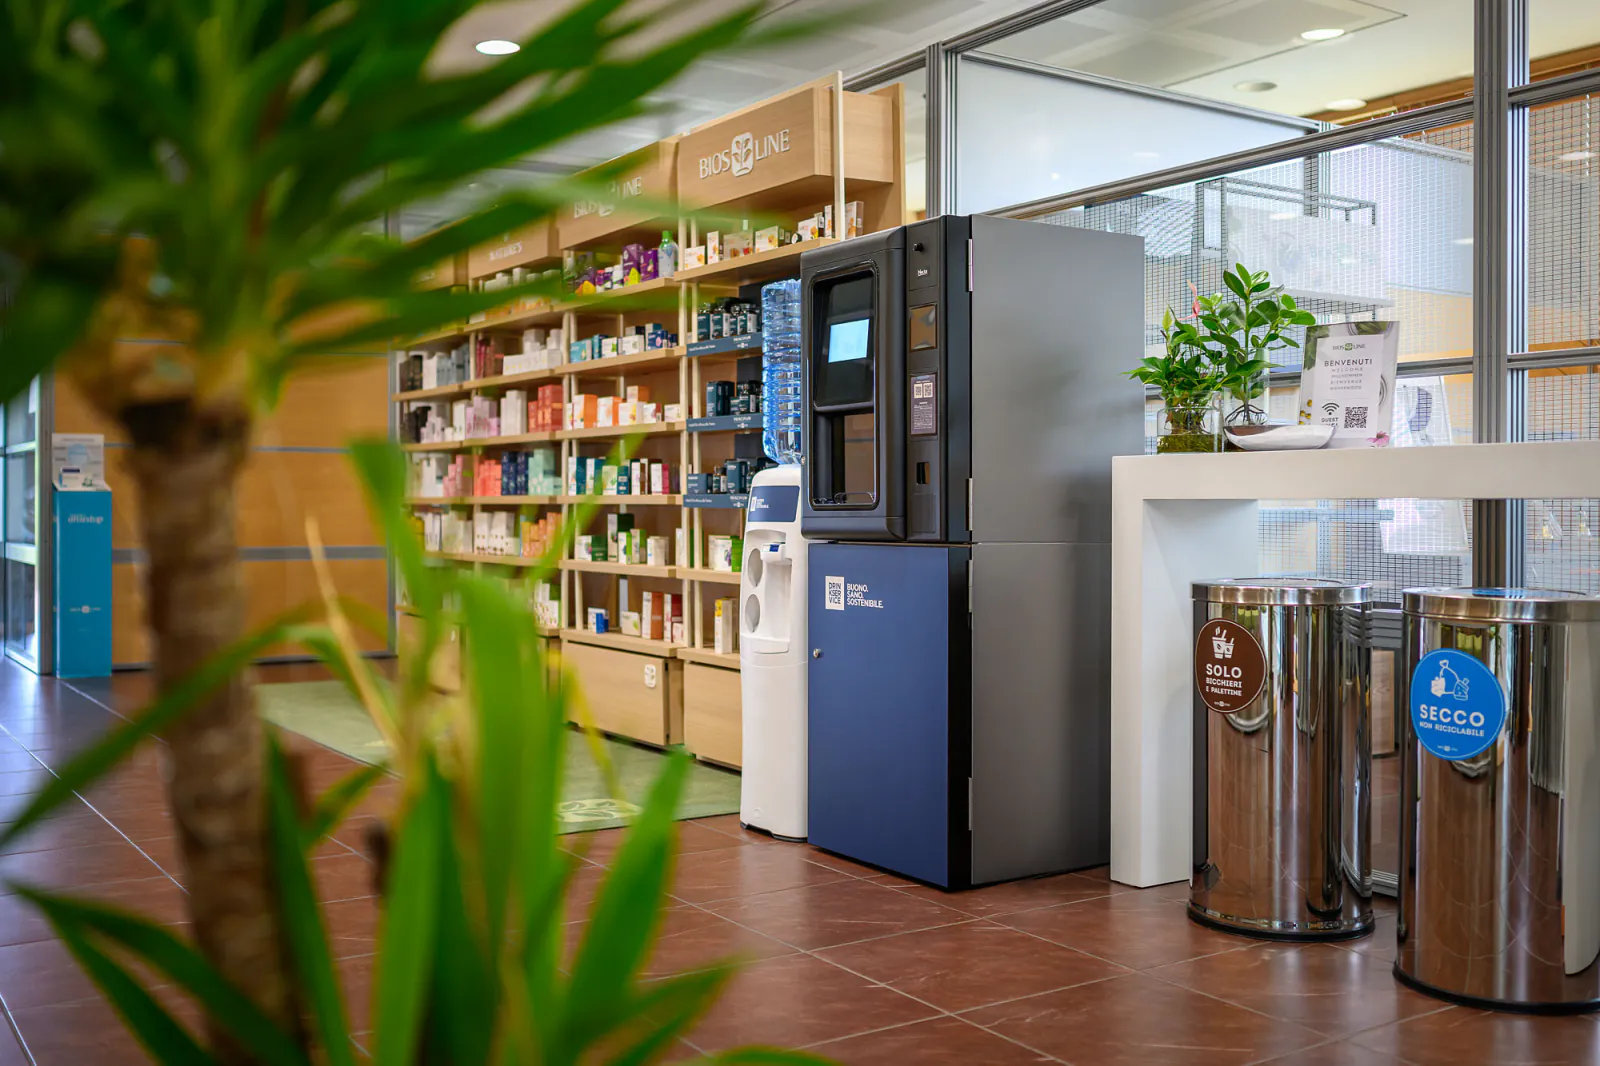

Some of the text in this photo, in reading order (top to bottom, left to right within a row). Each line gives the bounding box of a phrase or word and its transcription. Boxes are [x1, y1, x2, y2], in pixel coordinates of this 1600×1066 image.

[699, 128, 791, 179] BIOS LINE
[1324, 358, 1373, 367] BENVENUTI
[1205, 663, 1243, 679] SOLO
[1205, 677, 1243, 689] BICCHIERI
[1419, 703, 1486, 728] SECCO
[1419, 721, 1485, 738] NON RICICLABILE
